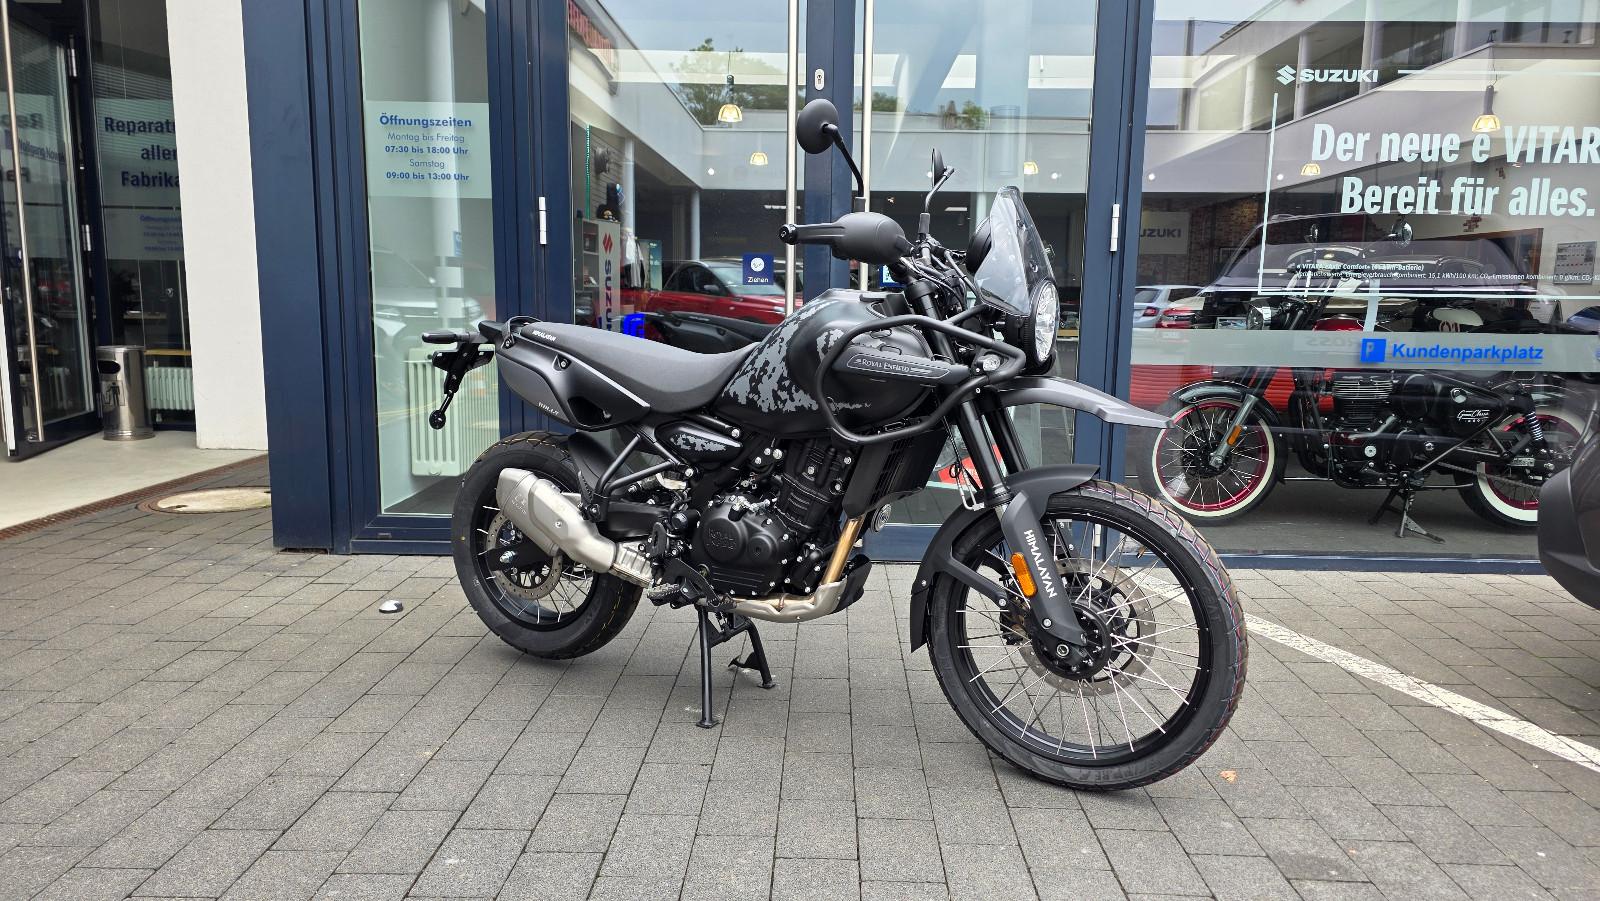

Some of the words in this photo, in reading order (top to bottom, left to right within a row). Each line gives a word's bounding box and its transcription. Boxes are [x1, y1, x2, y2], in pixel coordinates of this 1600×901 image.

[1300, 69, 1379, 83] SUZUKI
[380, 112, 472, 128] Öffnungszeiten
[387, 132, 419, 142] Montag
[422, 133, 434, 141] bis
[437, 133, 465, 143] Freitag
[1312, 123, 1370, 162] Der
[1380, 132, 1461, 163] neue
[1471, 132, 1491, 163] e
[1504, 125, 1600, 164] VITAR
[427, 146, 450, 154] 18:00
[409, 159, 445, 169] Samstag
[412, 172, 425, 180] bis
[454, 173, 470, 181] Uhr
[1341, 176, 1441, 214] Bereit
[1450, 177, 1499, 215] für
[1508, 177, 1595, 216] alles.
[1392, 343, 1543, 362] Kundenparkplatz
[861, 358, 882, 368] ROYAL
[1023, 529, 1058, 599] HIMALAYAN
